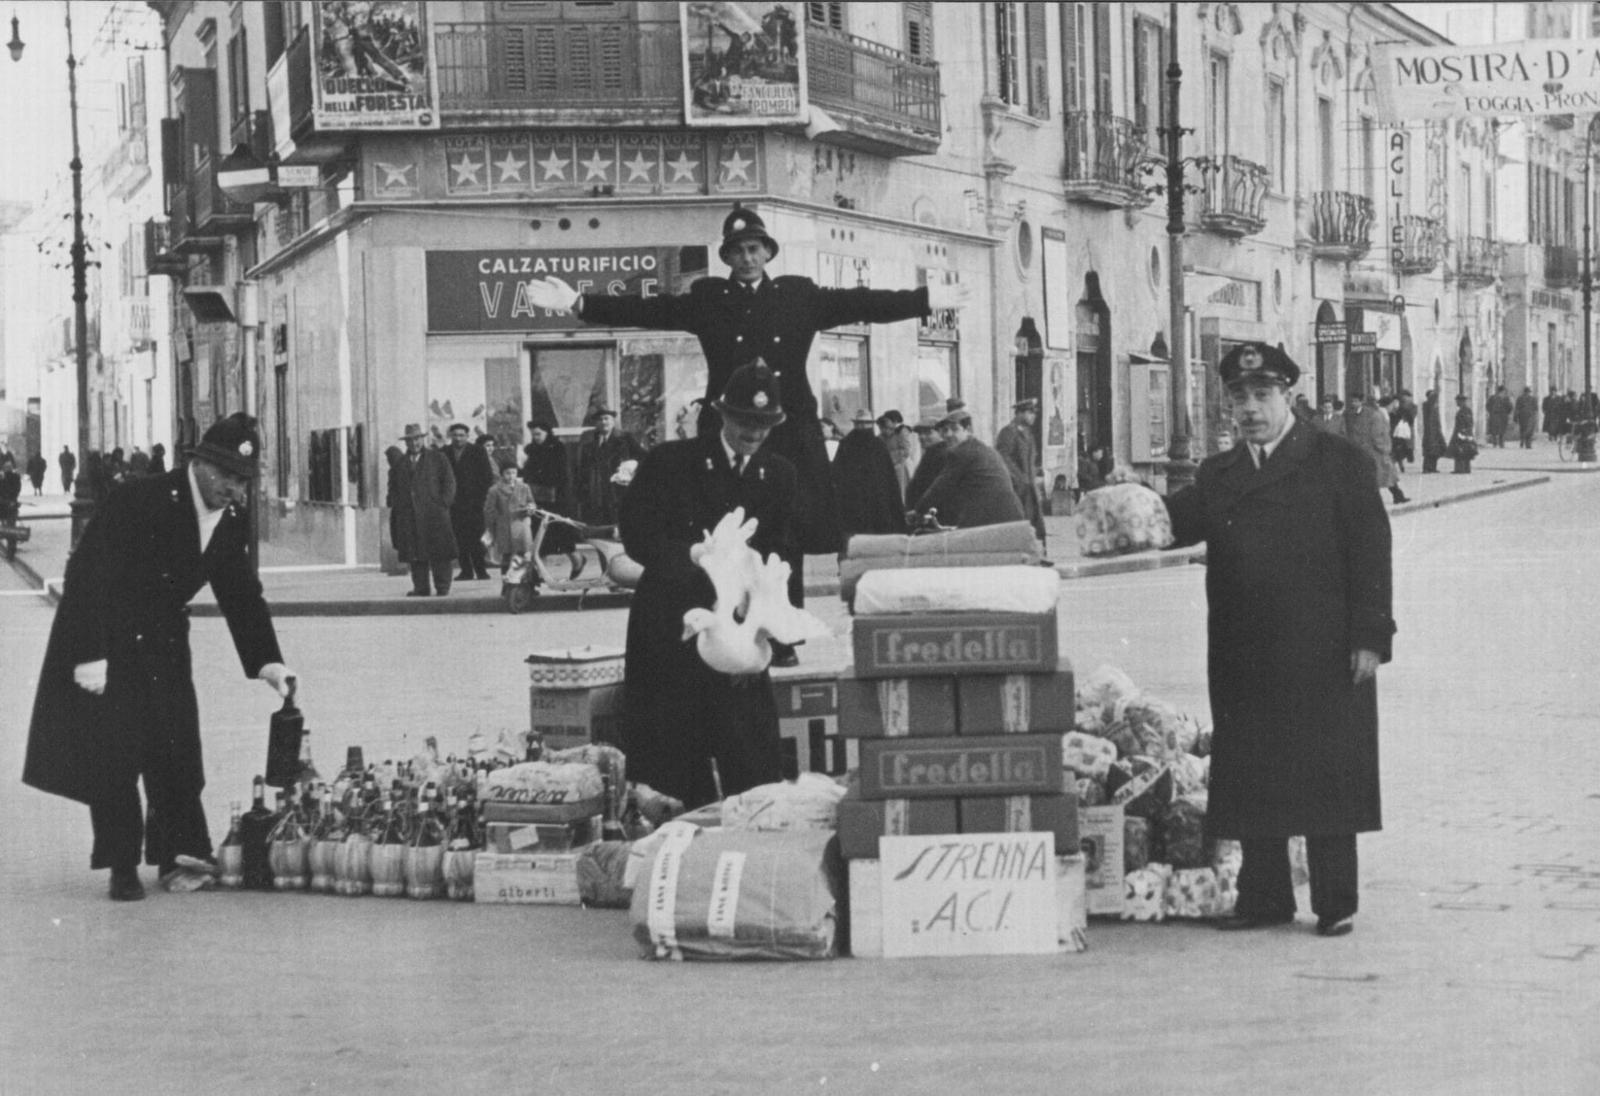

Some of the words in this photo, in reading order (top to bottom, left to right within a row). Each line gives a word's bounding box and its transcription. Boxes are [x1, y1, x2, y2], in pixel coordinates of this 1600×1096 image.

[1396, 52, 1530, 85] MOSTRA
[356, 94, 426, 112] FORESTA
[1464, 95, 1534, 112] FOGGIA
[478, 255, 657, 274] CALZATURIFICIO
[479, 278, 659, 318] VAE
[888, 631, 1028, 662] fredella
[893, 752, 1034, 784] fredella
[893, 840, 1047, 881] STRENNA
